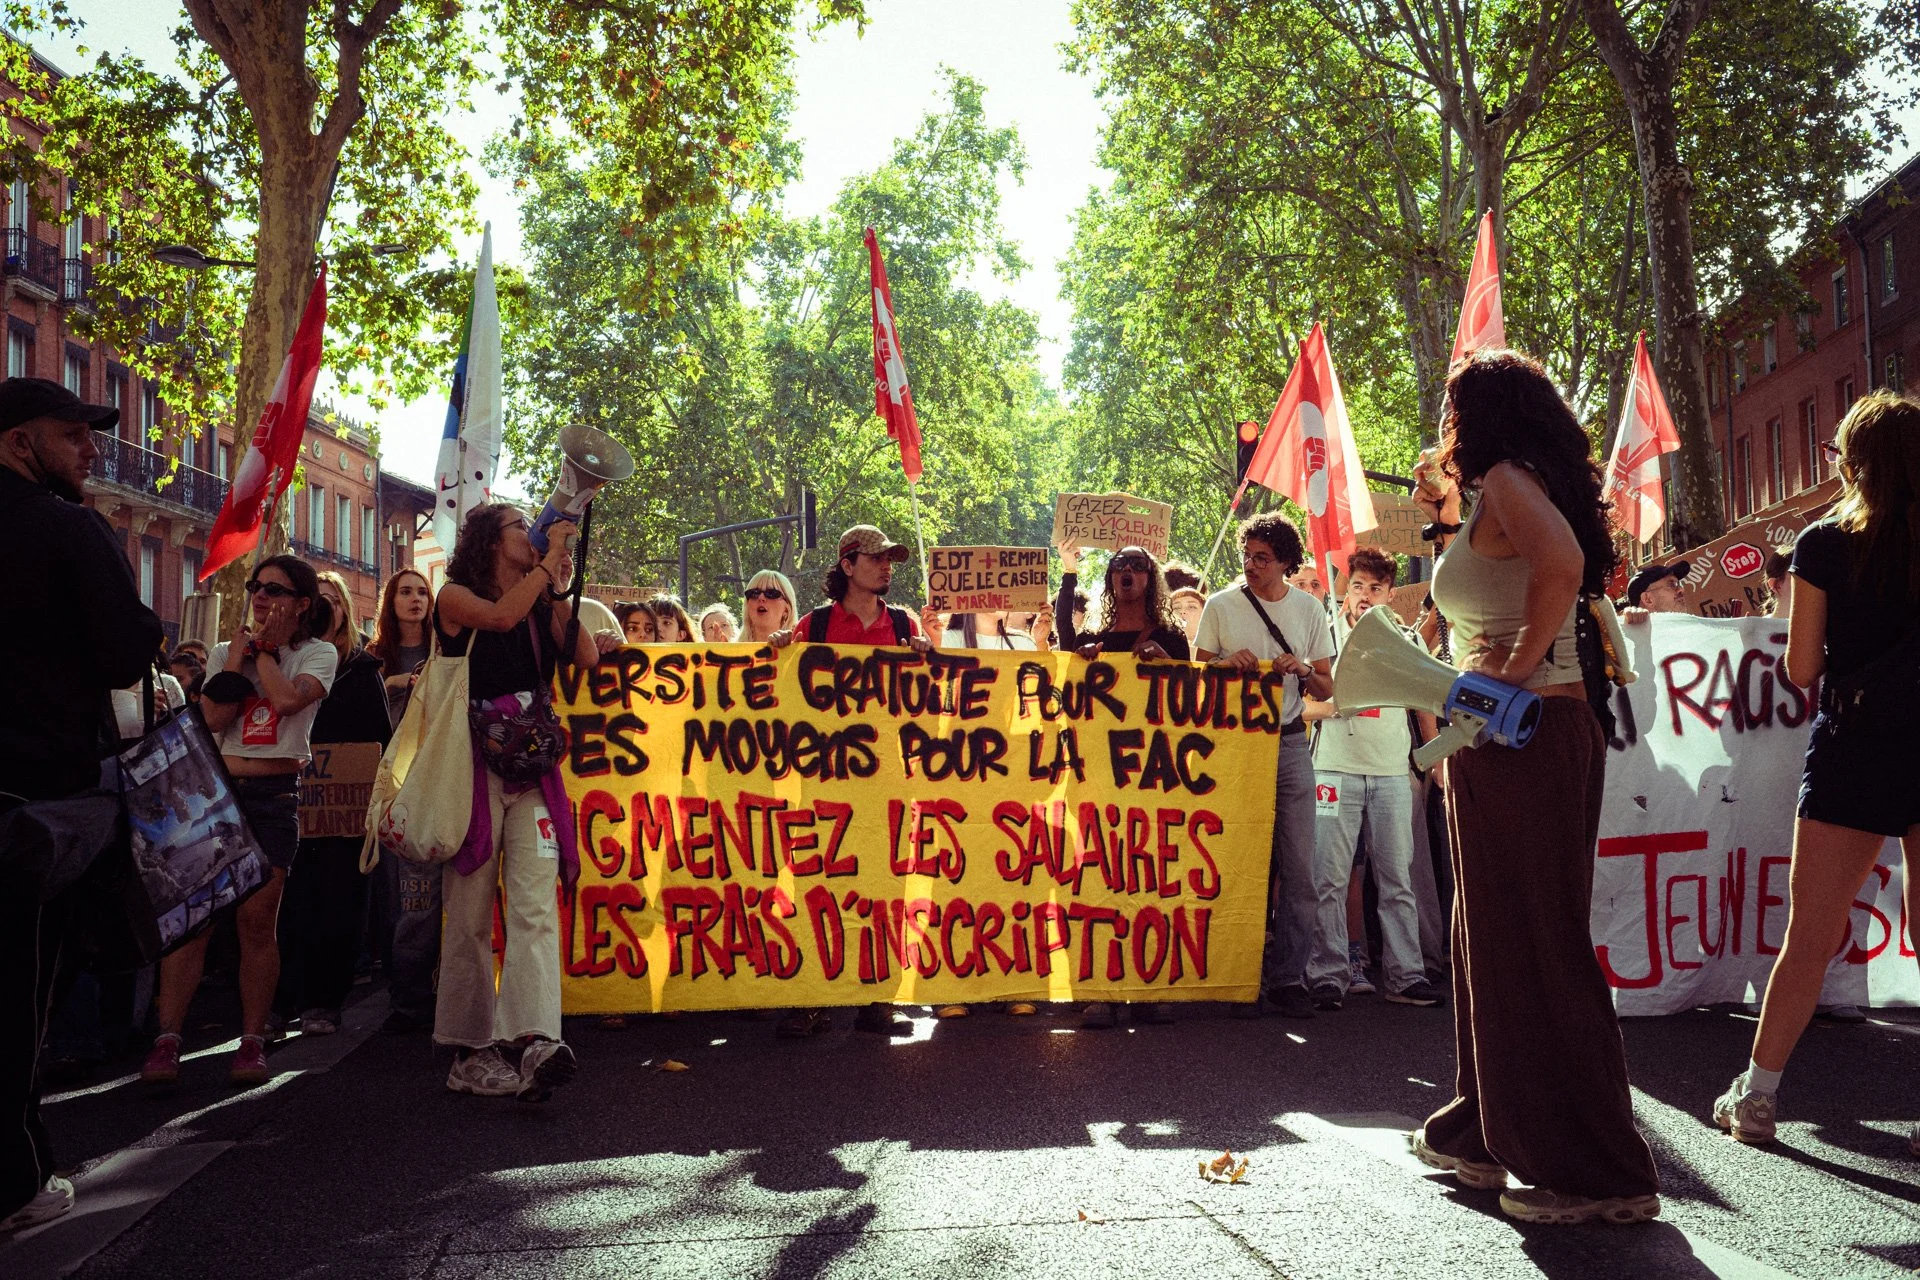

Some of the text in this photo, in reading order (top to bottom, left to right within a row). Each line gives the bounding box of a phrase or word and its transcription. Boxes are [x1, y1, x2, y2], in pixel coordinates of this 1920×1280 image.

[1066, 495, 1126, 515] GAZEZ
[1063, 524, 1089, 538] PAS
[1092, 527, 1117, 541] LES
[1065, 511, 1166, 538] LES VIOLEURS
[1765, 522, 1800, 546] 400
[932, 551, 974, 570] EDT
[928, 570, 975, 592] QUE
[976, 572, 995, 590] LE
[932, 595, 952, 611] DE
[552, 646, 780, 711] VERSiTÉ
[1017, 659, 1127, 722] POUR
[1136, 663, 1284, 735] TOUT.ES
[898, 722, 1008, 783] POUR
[1028, 727, 1086, 784] LA
[1108, 729, 1217, 796] FAC
[567, 790, 859, 881] GMENTEZ
[886, 798, 968, 884] LES
[557, 882, 648, 979] LES
